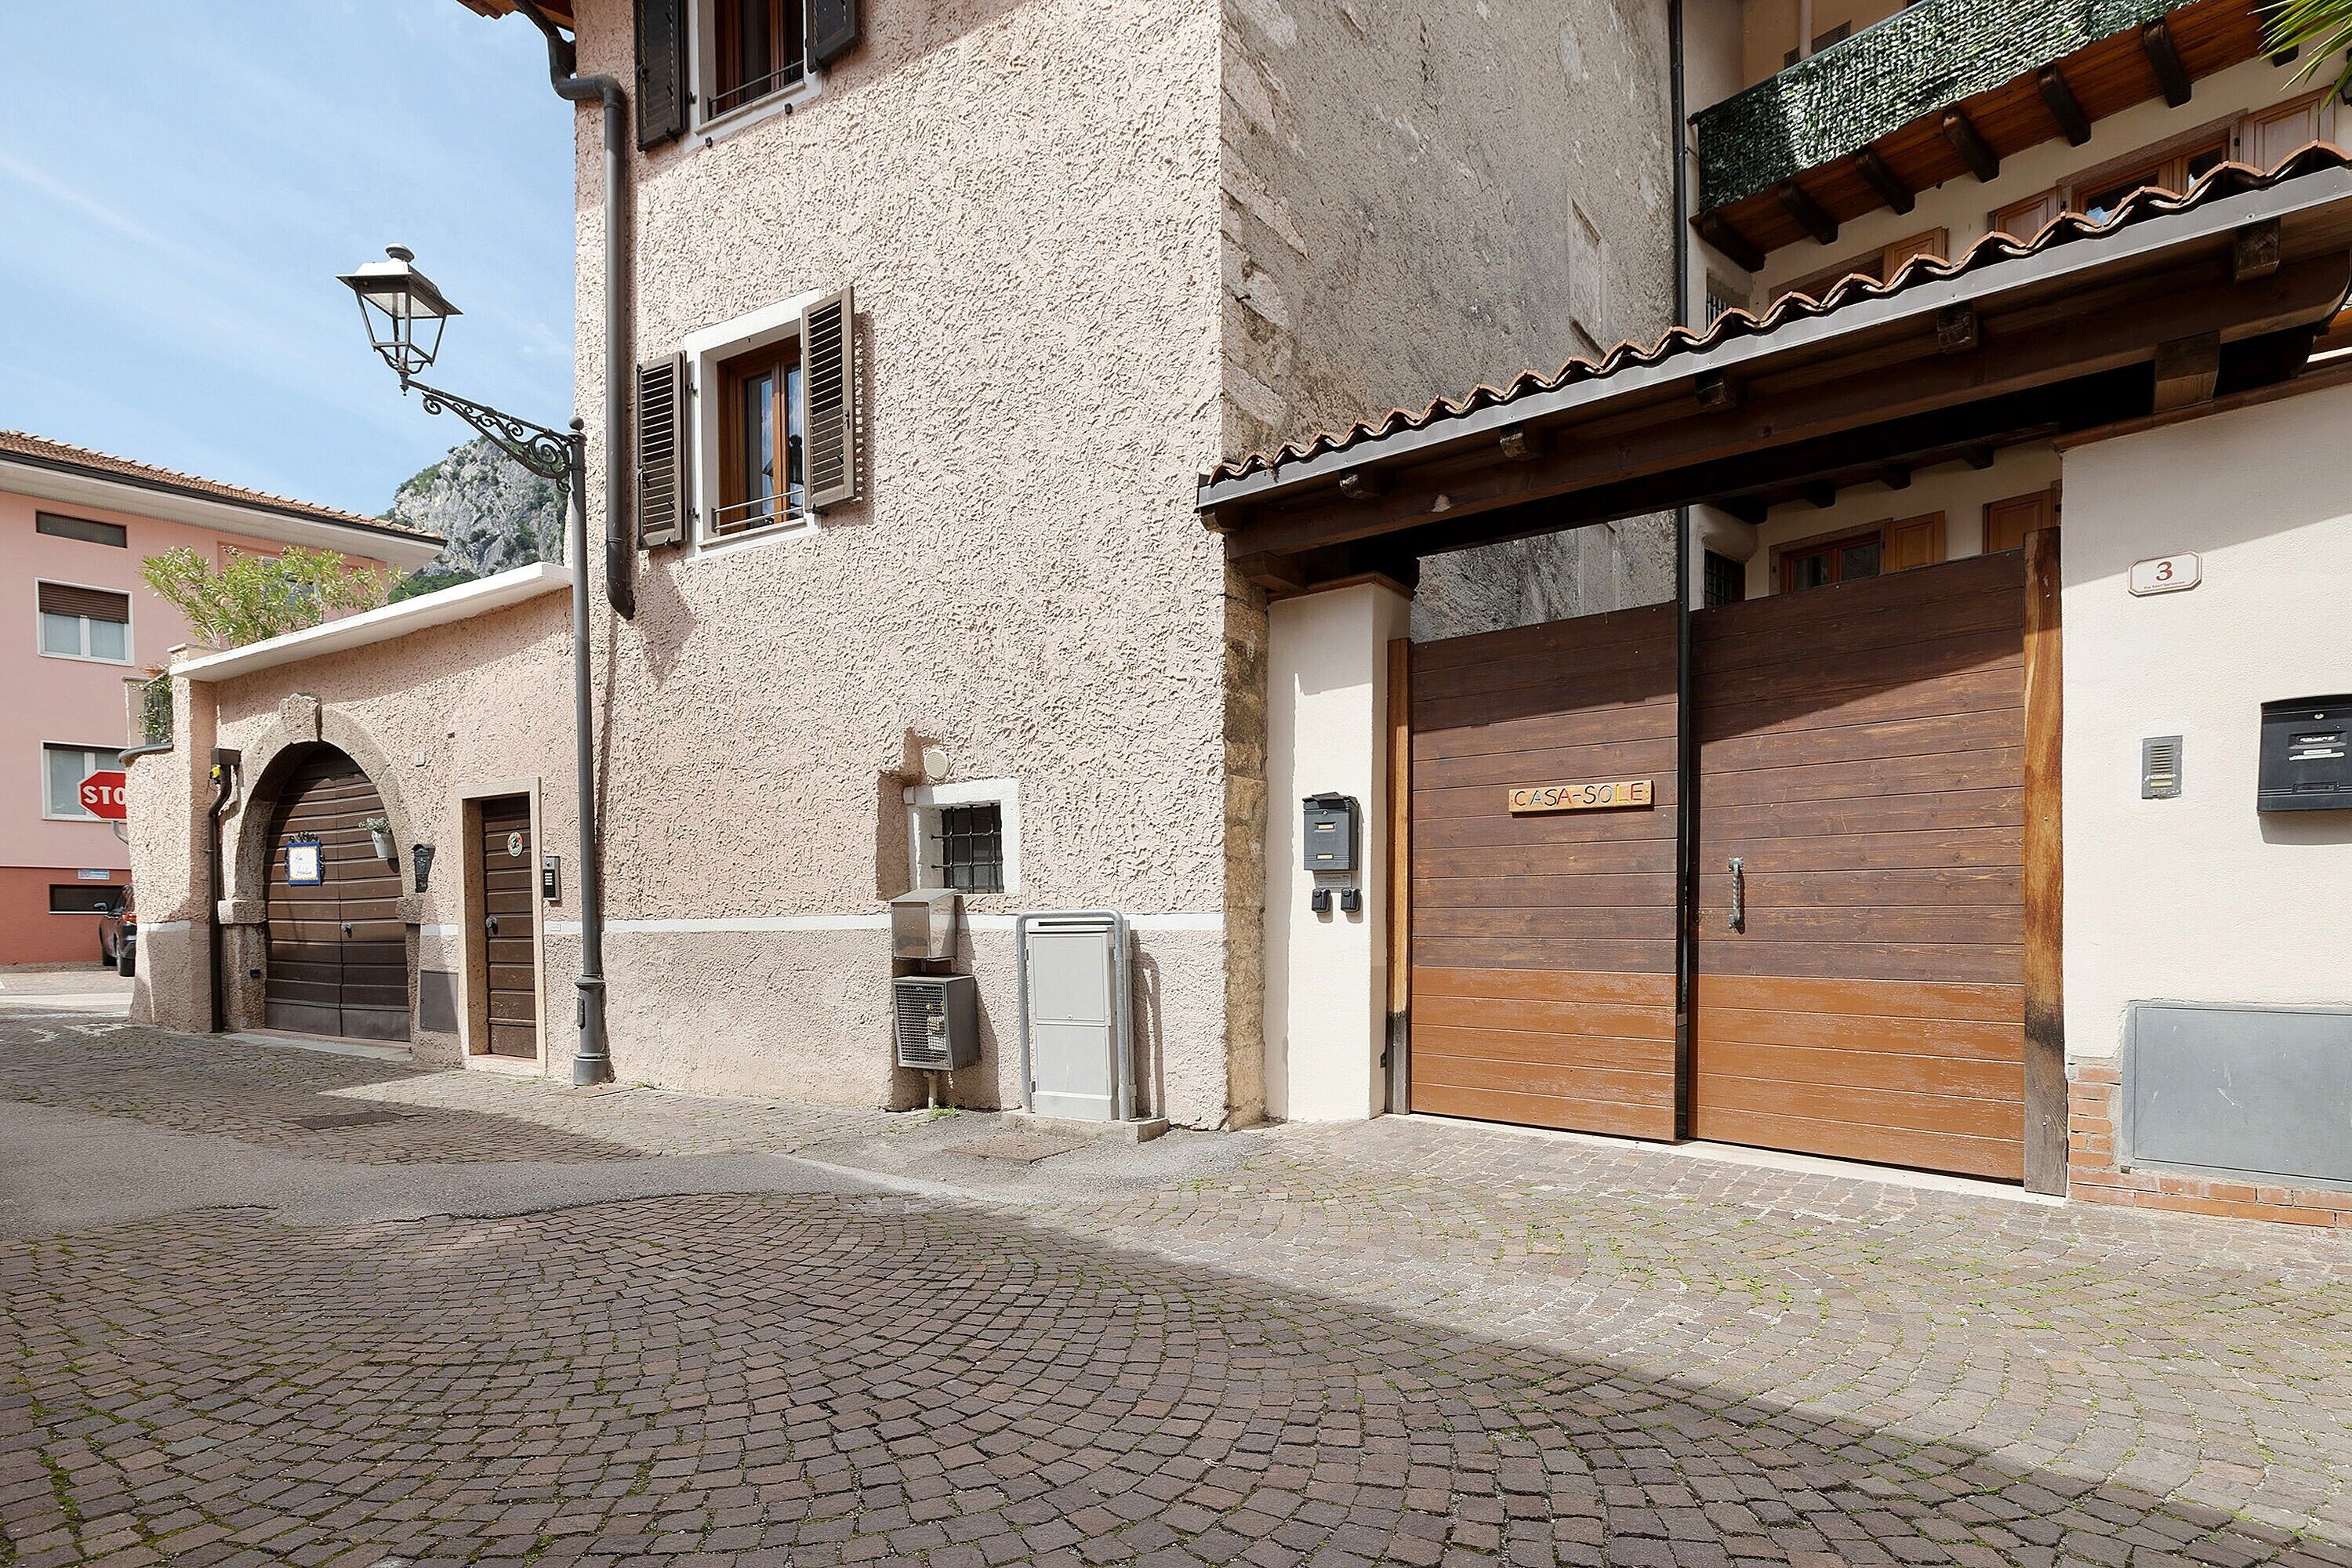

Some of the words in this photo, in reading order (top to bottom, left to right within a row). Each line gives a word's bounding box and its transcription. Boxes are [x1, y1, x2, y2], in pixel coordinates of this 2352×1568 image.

[2156, 561, 2172, 581] 3
[82, 786, 125, 805] STO
[1514, 782, 1644, 807] CASA-SOLE
